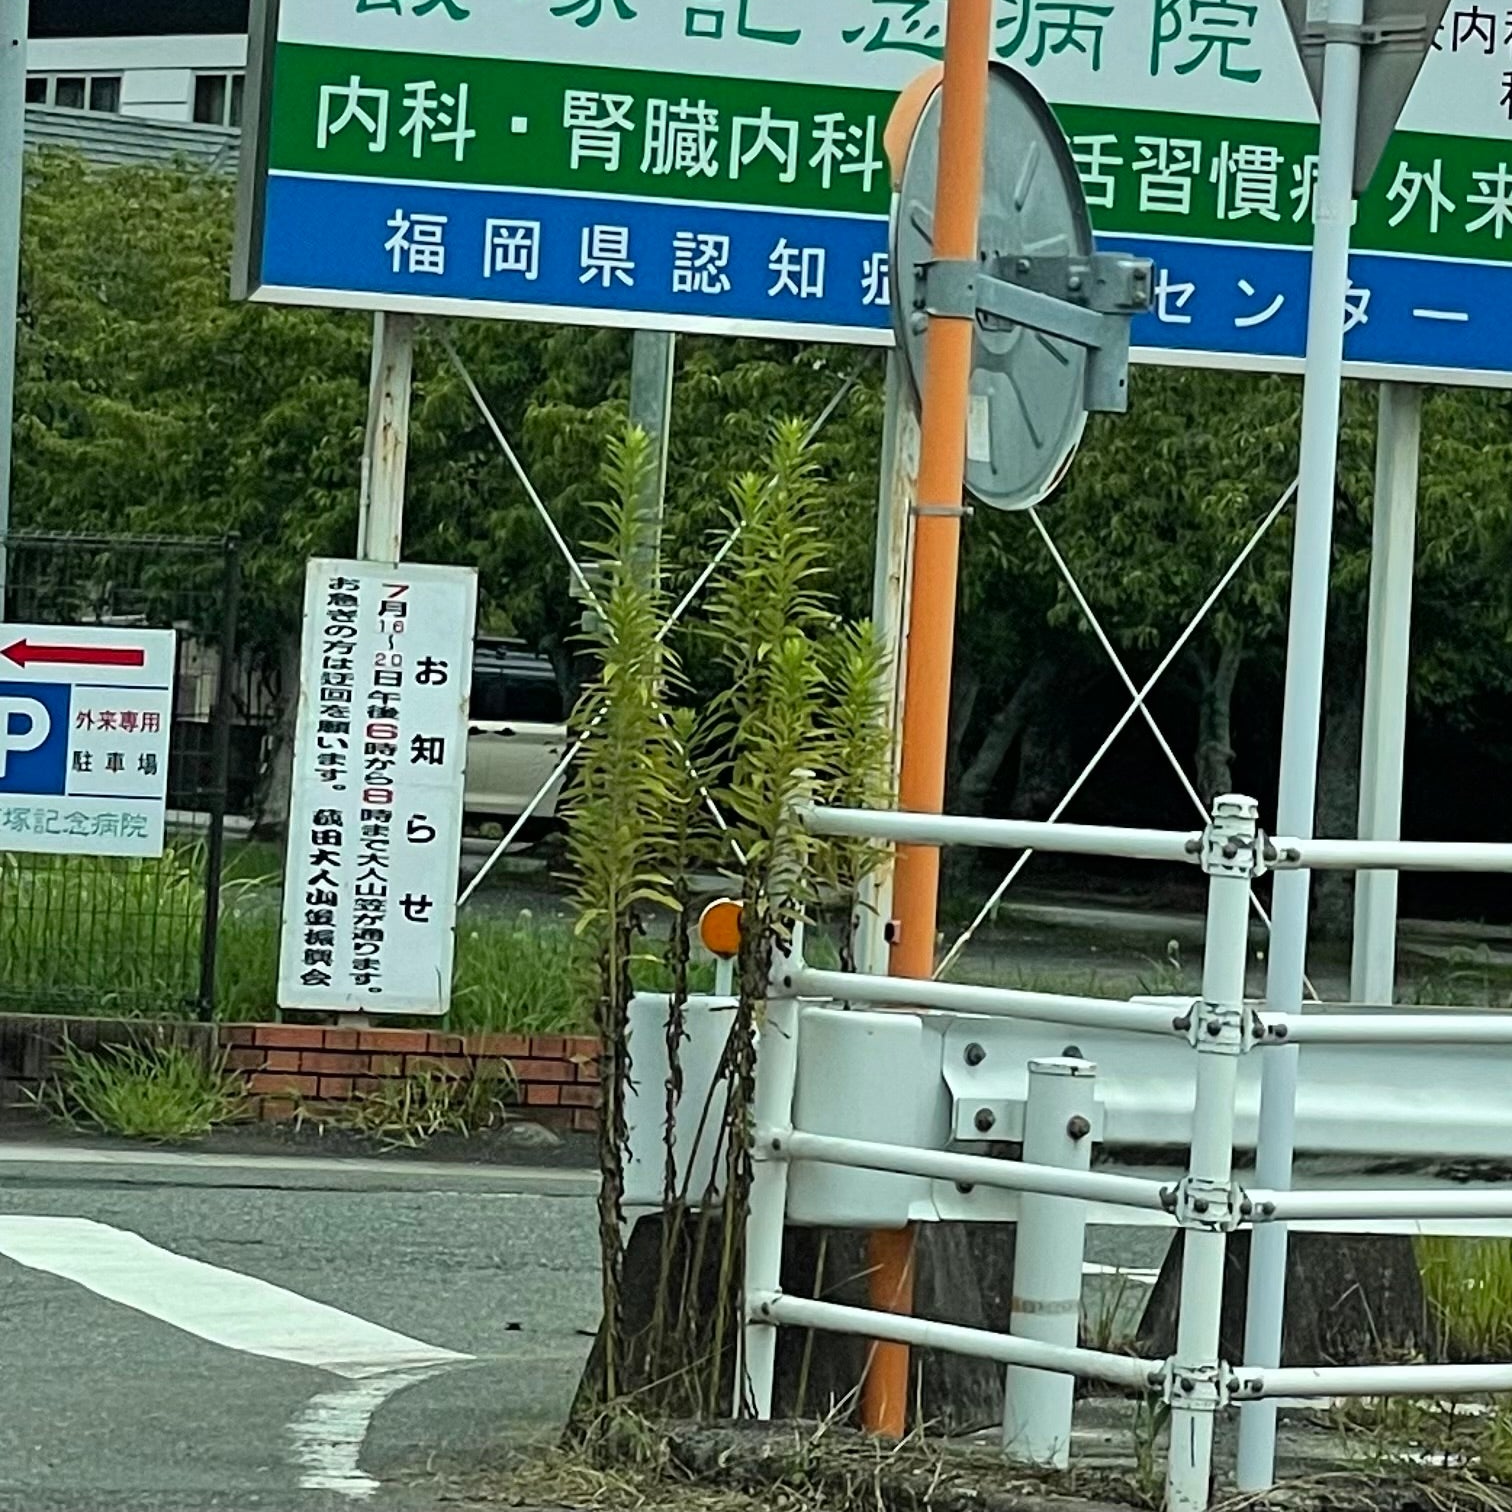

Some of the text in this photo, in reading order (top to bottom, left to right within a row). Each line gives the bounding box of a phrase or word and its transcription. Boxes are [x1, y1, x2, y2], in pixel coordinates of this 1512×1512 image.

[0, 696, 51, 778] P
[75, 709, 160, 733] 外来専用
[71, 750, 158, 776] 駐車場
[400, 656, 448, 923] お知らせ
[0, 806, 149, 839] 塚記念病院
